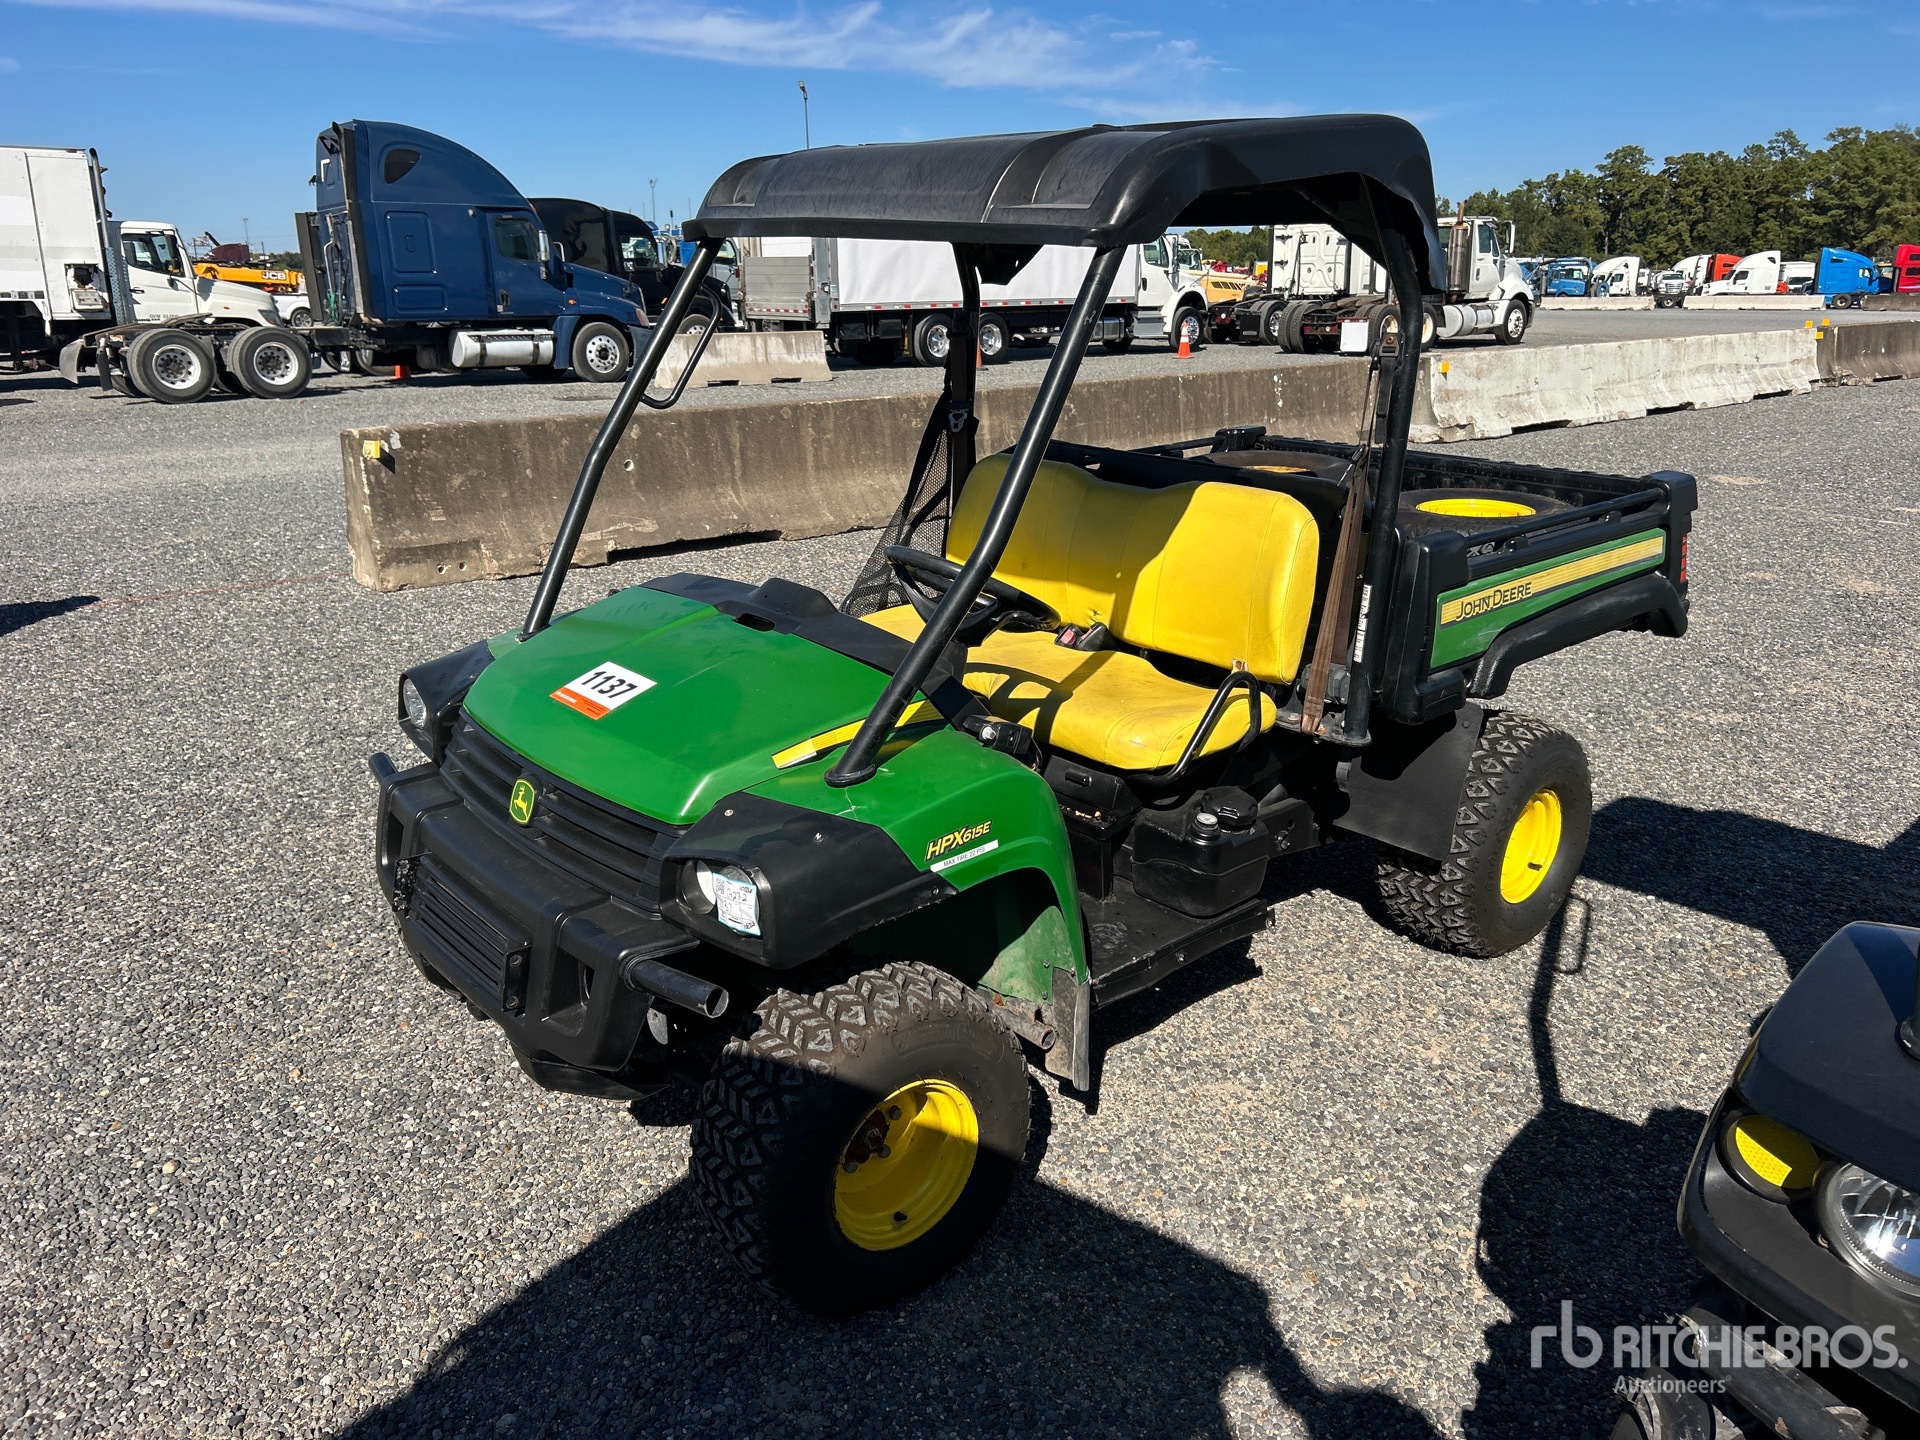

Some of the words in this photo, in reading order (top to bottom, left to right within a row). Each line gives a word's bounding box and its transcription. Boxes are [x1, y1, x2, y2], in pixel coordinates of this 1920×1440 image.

[261, 271, 286, 280] JCB
[1456, 594, 1492, 621] JOHN
[1493, 581, 1532, 608] DEERE
[581, 670, 638, 698] 1137
[926, 820, 992, 860] HPX615E
[943, 858, 956, 868] MAX
[956, 852, 969, 862] TIRE
[969, 850, 976, 859] 22
[976, 846, 986, 855] PSI
